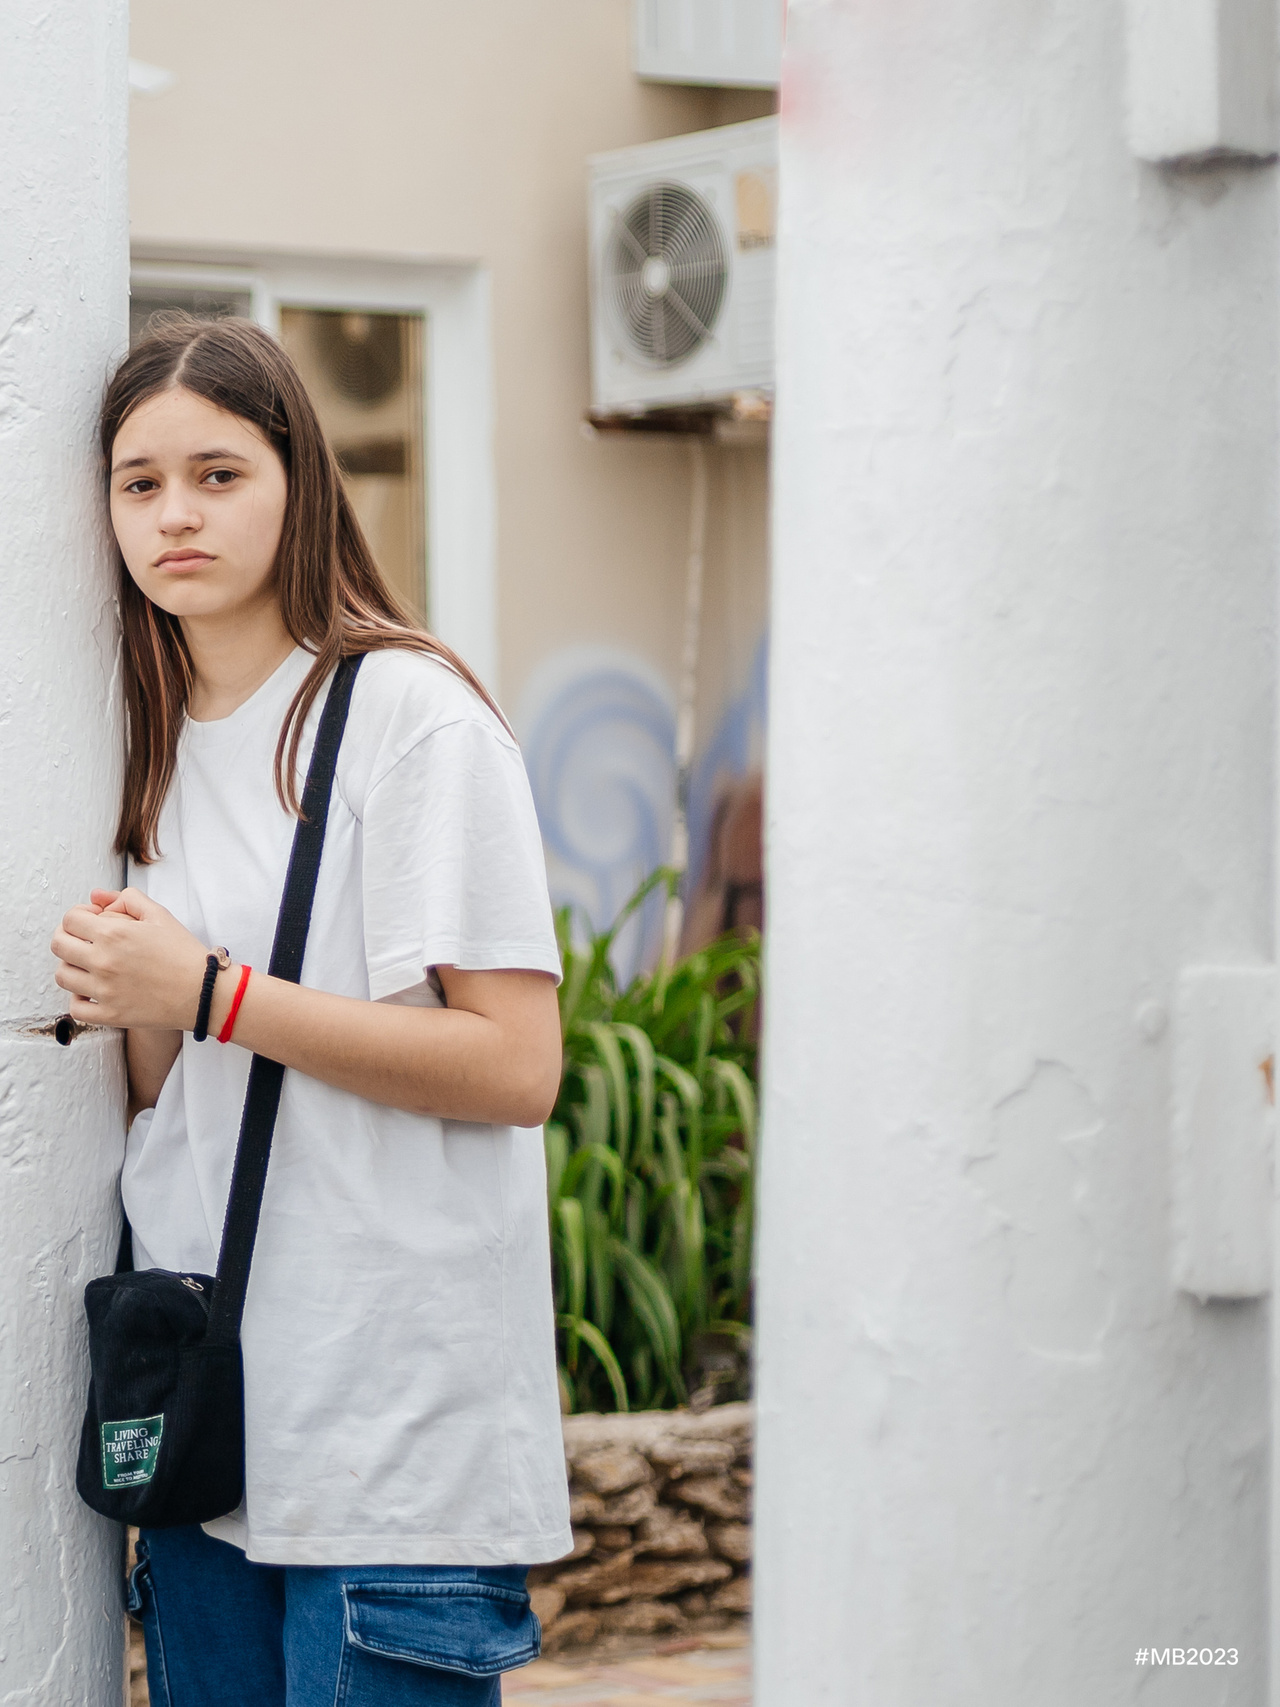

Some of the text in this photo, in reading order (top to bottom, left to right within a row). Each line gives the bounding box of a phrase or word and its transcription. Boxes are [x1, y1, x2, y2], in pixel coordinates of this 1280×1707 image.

[114, 1428, 148, 1441] LIVING
[106, 1436, 159, 1453] TRAVELING
[114, 1449, 149, 1463] SHARE
